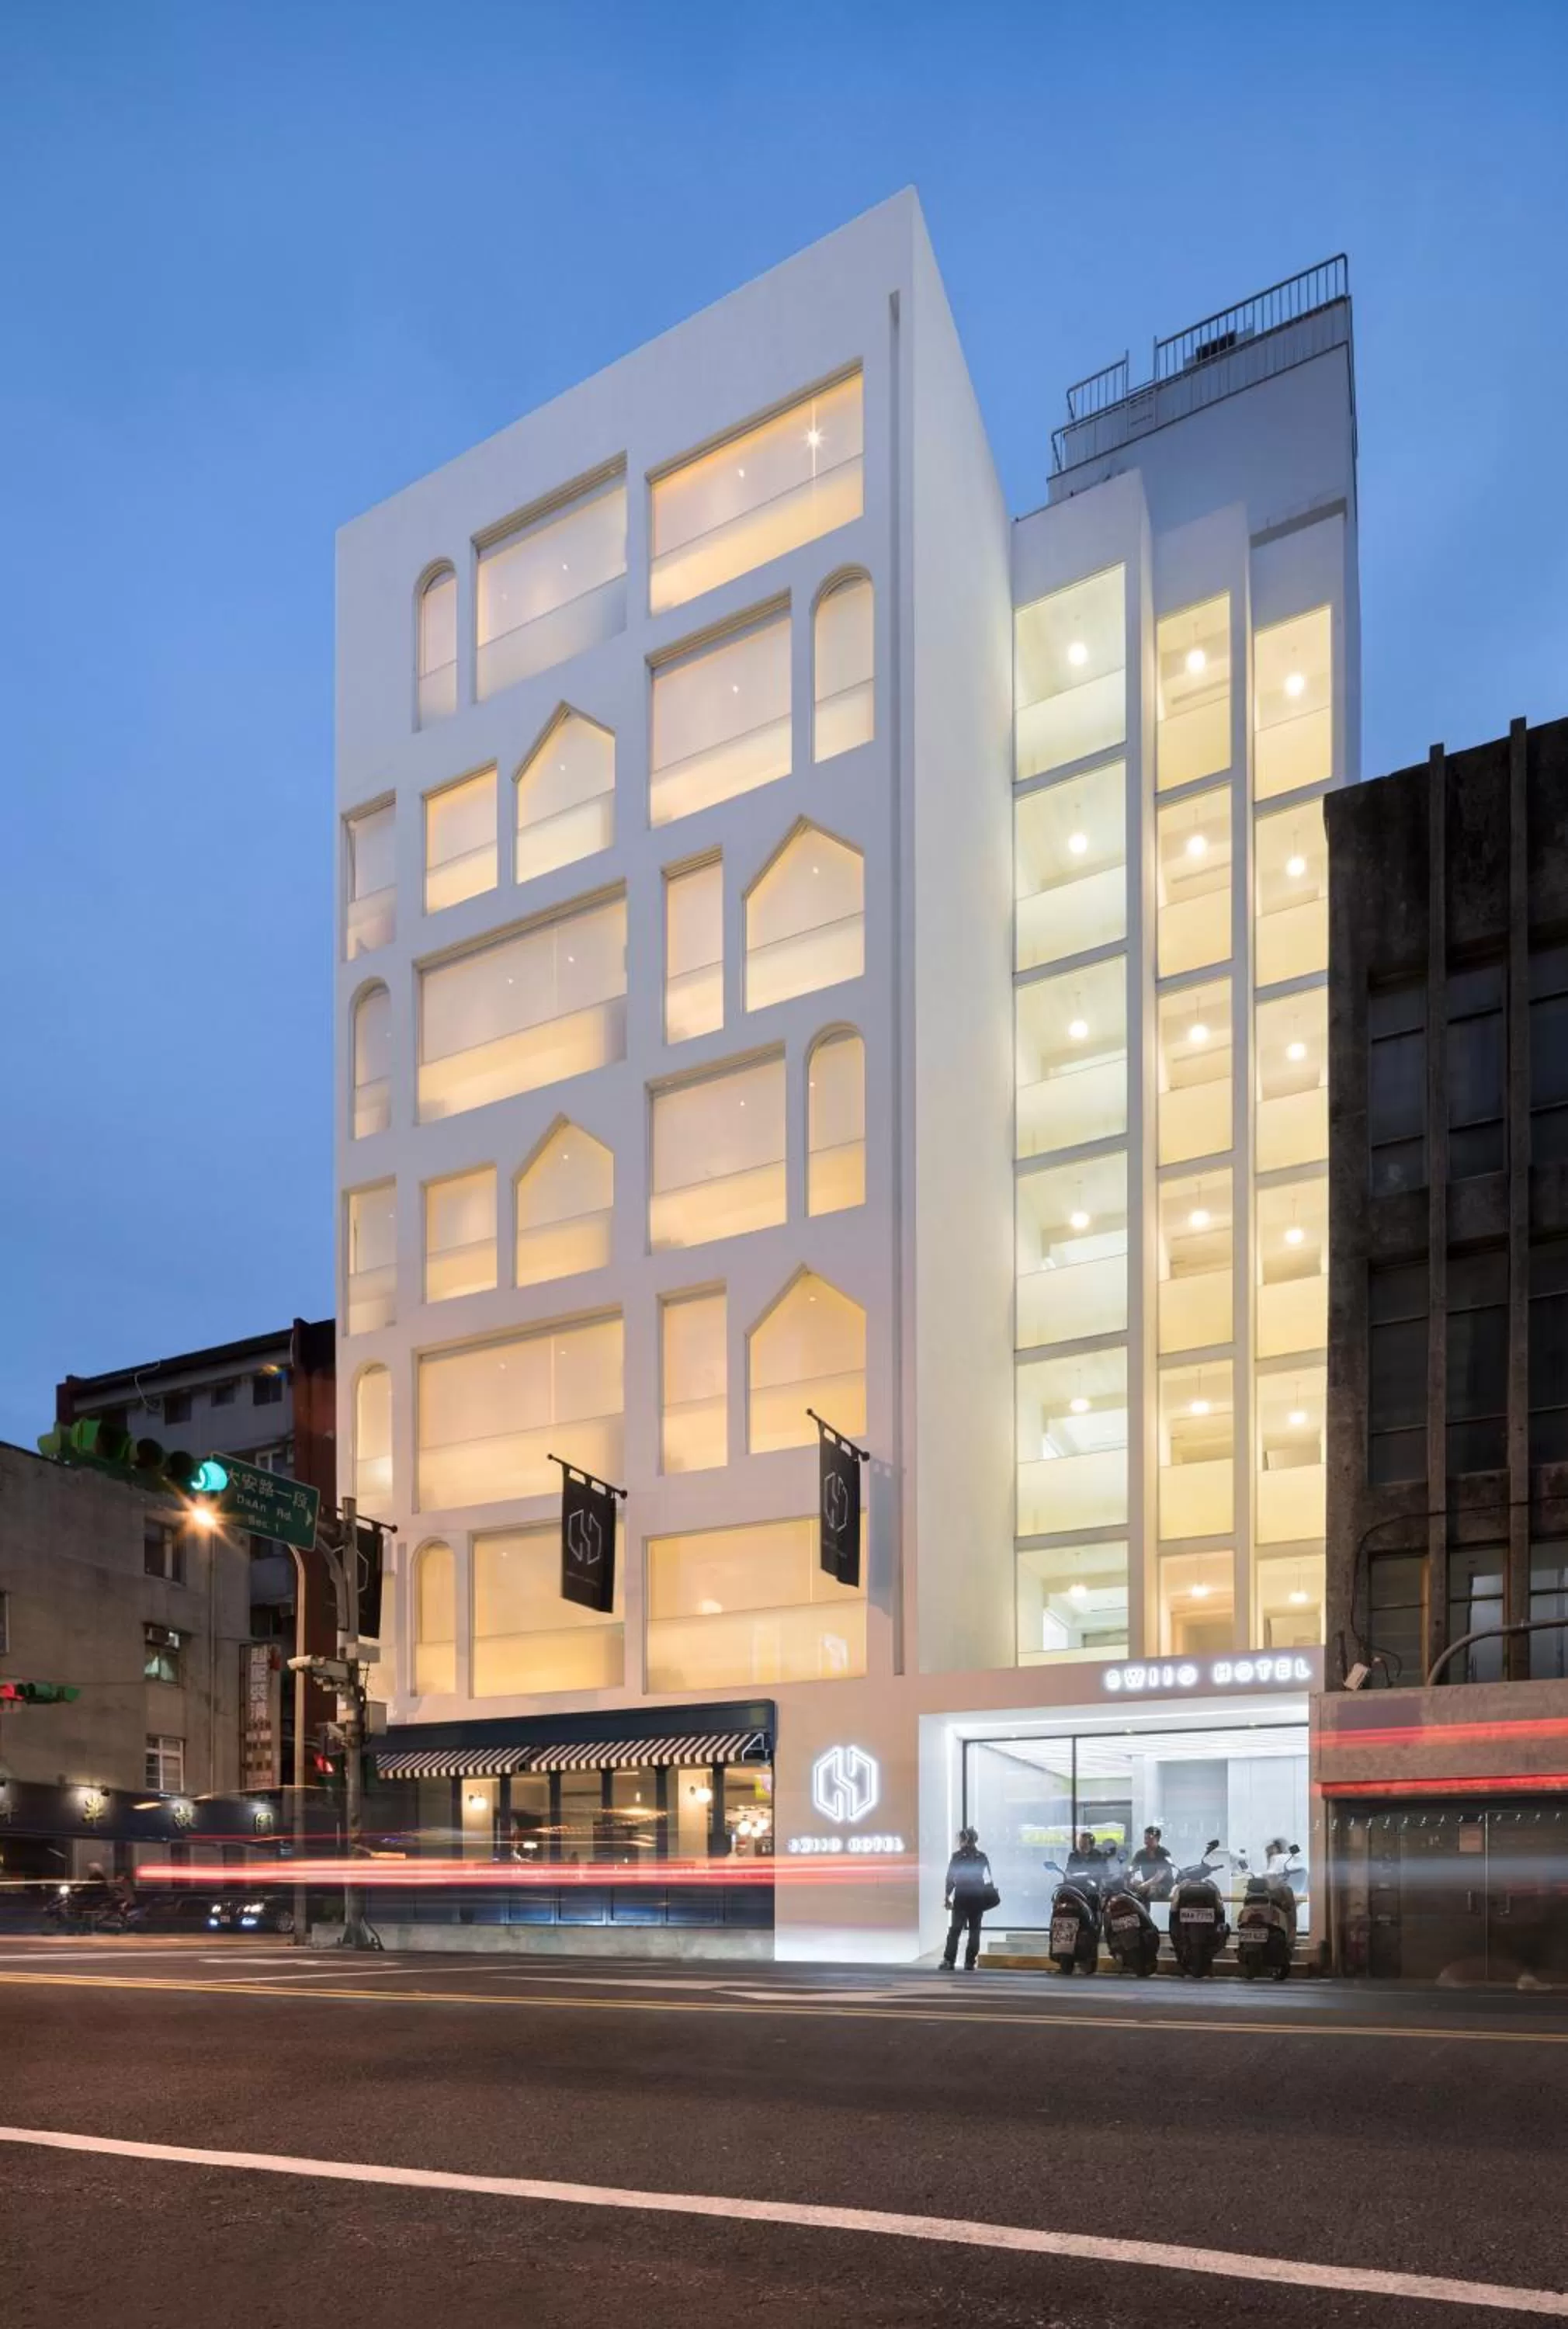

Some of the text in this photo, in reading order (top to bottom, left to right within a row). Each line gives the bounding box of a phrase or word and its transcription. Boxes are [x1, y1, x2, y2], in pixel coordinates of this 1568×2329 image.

[228, 1467, 309, 1509] 大安路一段
[237, 1493, 266, 1512] DaAn
[1105, 1657, 1312, 1691] SWIIO HOTEL
[848, 1835, 905, 1853] HOTEL
